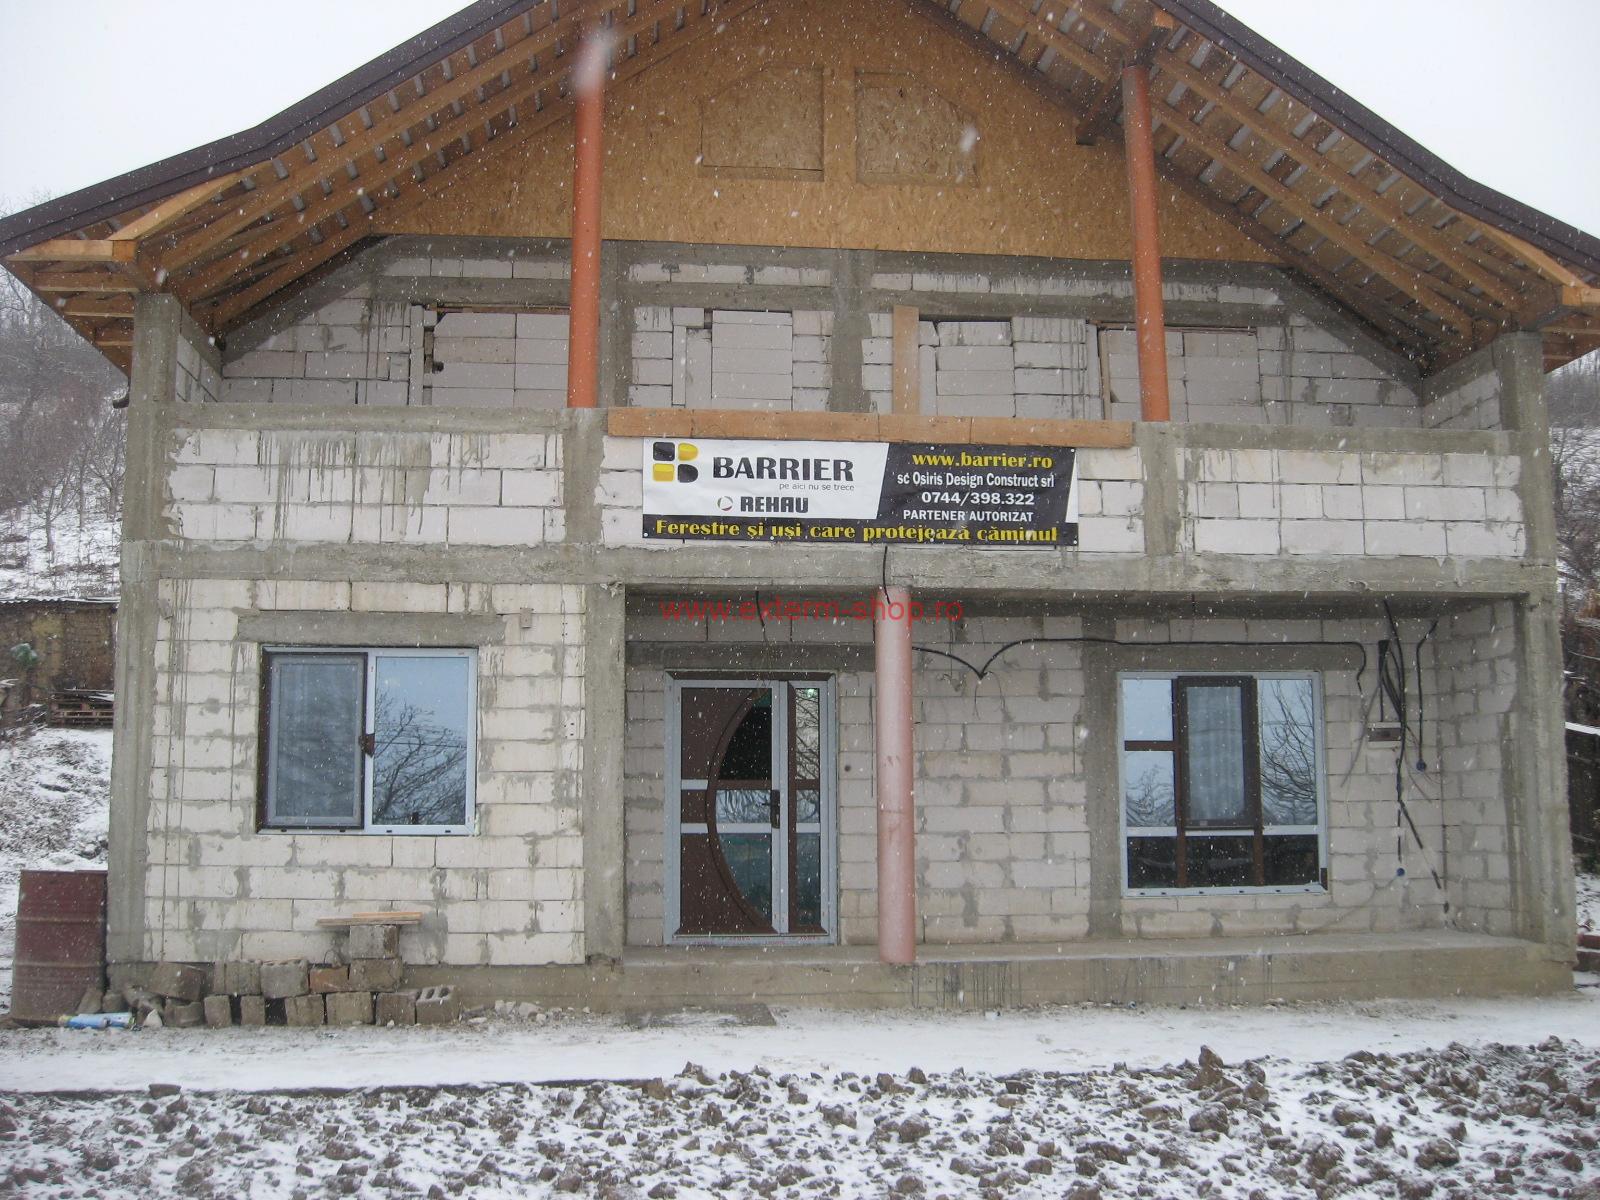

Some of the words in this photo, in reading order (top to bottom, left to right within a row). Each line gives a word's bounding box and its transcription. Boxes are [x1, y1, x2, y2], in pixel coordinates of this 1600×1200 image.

[713, 456, 854, 482] BARRIER
[912, 452, 1053, 469] www.barrier.ro
[897, 474, 910, 485] sc
[913, 471, 943, 487] Osiris
[946, 473, 984, 488] Design
[986, 473, 1039, 488] Construct
[1041, 474, 1055, 488] srl
[740, 496, 808, 513] REHAU
[921, 491, 1035, 506] 0744/398.322
[903, 509, 966, 521] PARTENER
[969, 511, 1034, 523] AUTORIZAT
[656, 520, 740, 536] Ferestre
[810, 525, 856, 538] care
[863, 525, 971, 543] protejează
[977, 526, 1058, 542] căminul
